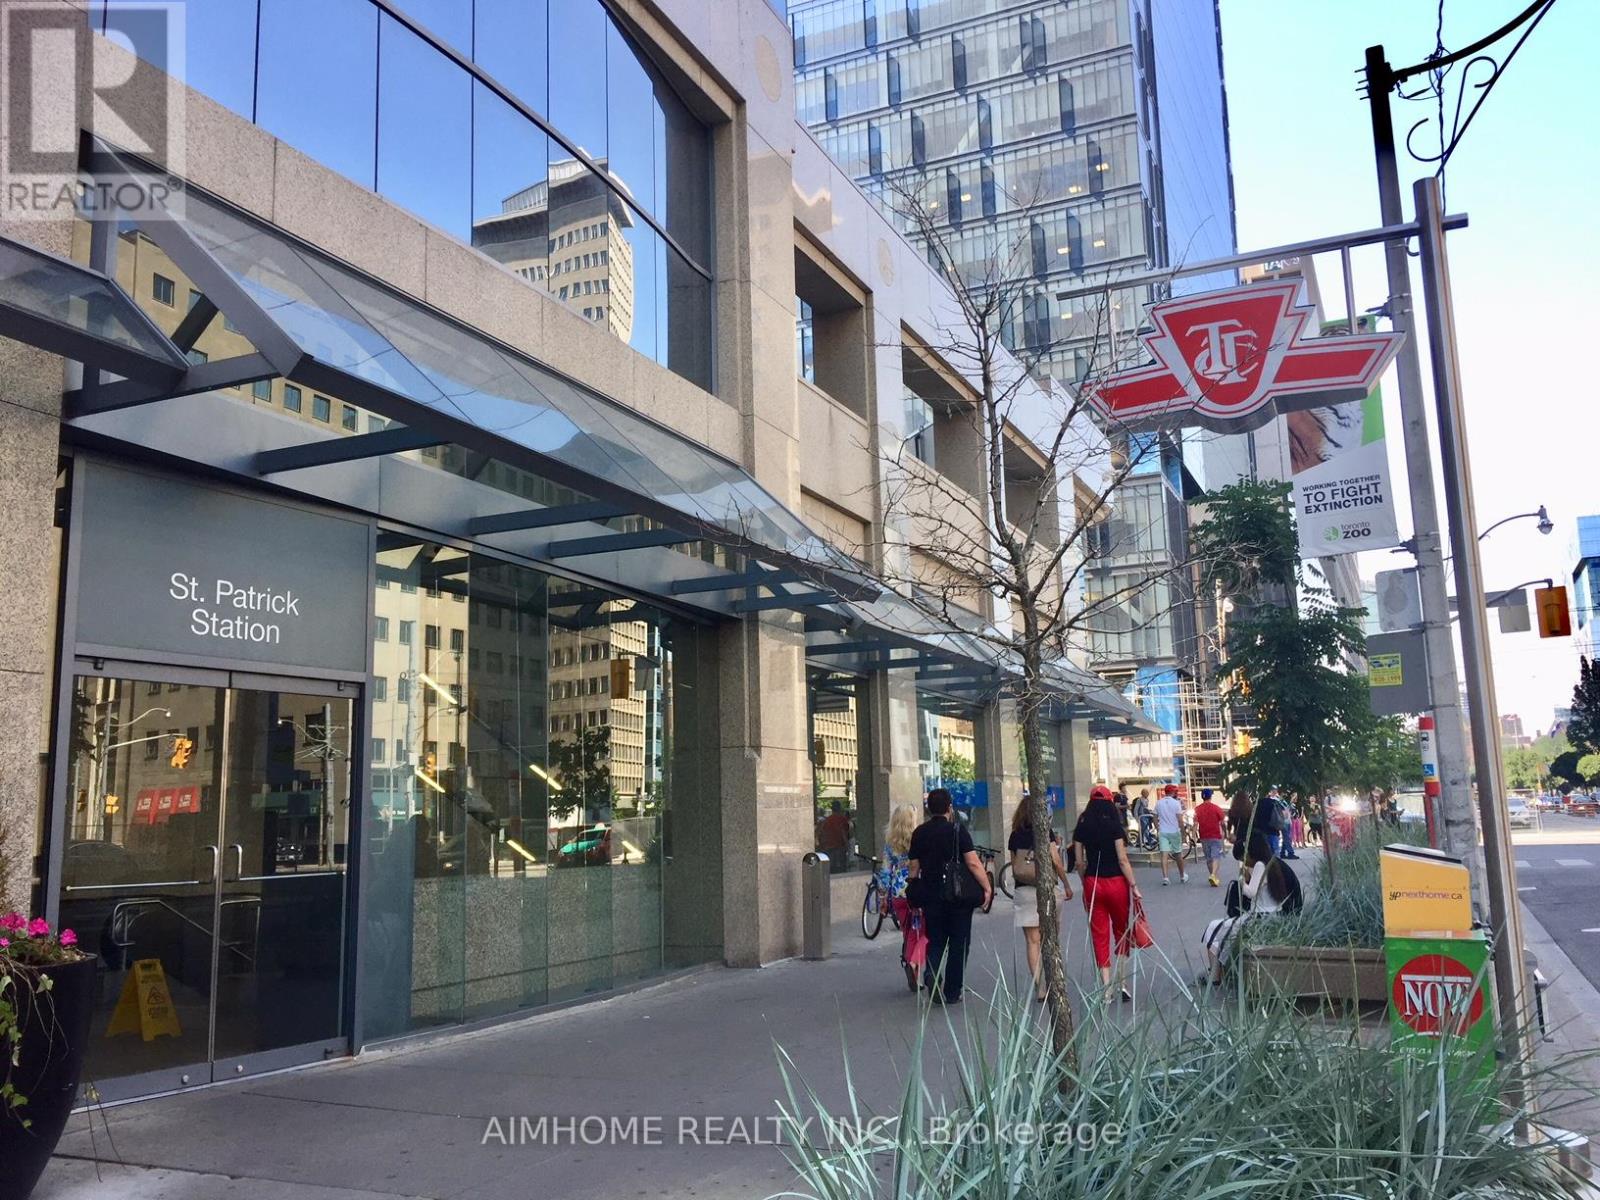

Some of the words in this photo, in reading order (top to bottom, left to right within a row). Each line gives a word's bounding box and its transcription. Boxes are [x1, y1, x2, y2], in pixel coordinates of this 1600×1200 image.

[1302, 481, 1337, 492] WORKING
[1339, 474, 1380, 486] TOGETHER
[1303, 491, 1326, 504] TO
[1331, 482, 1381, 500] FIGHT
[1304, 495, 1383, 514] EXTINCTION
[1341, 521, 1370, 530] toronto
[1342, 528, 1371, 539] ZOO
[170, 572, 205, 603] St.
[216, 579, 299, 616] Patrick
[191, 608, 280, 643] Station
[1401, 981, 1469, 1018] NOW
